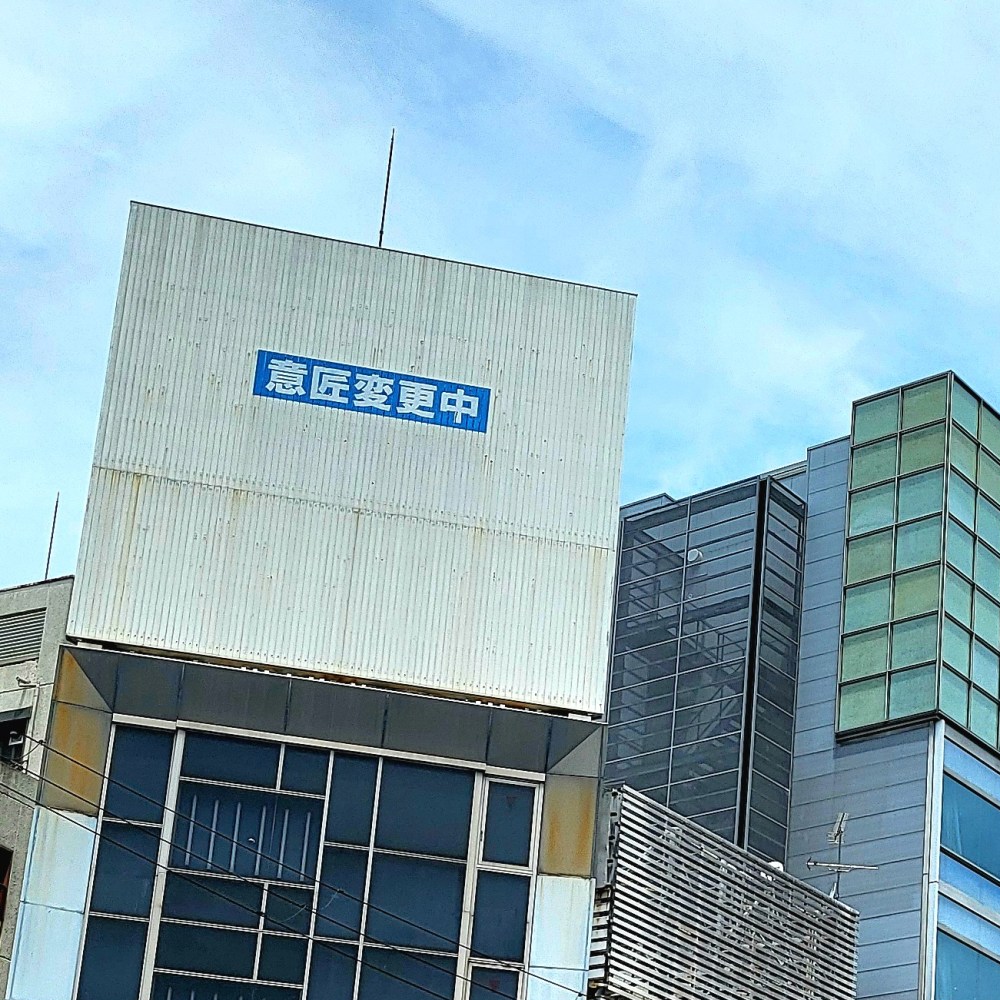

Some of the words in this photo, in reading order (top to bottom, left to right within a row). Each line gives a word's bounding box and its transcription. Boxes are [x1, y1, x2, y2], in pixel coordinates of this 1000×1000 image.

[265, 358, 480, 424] 意匠変更中
